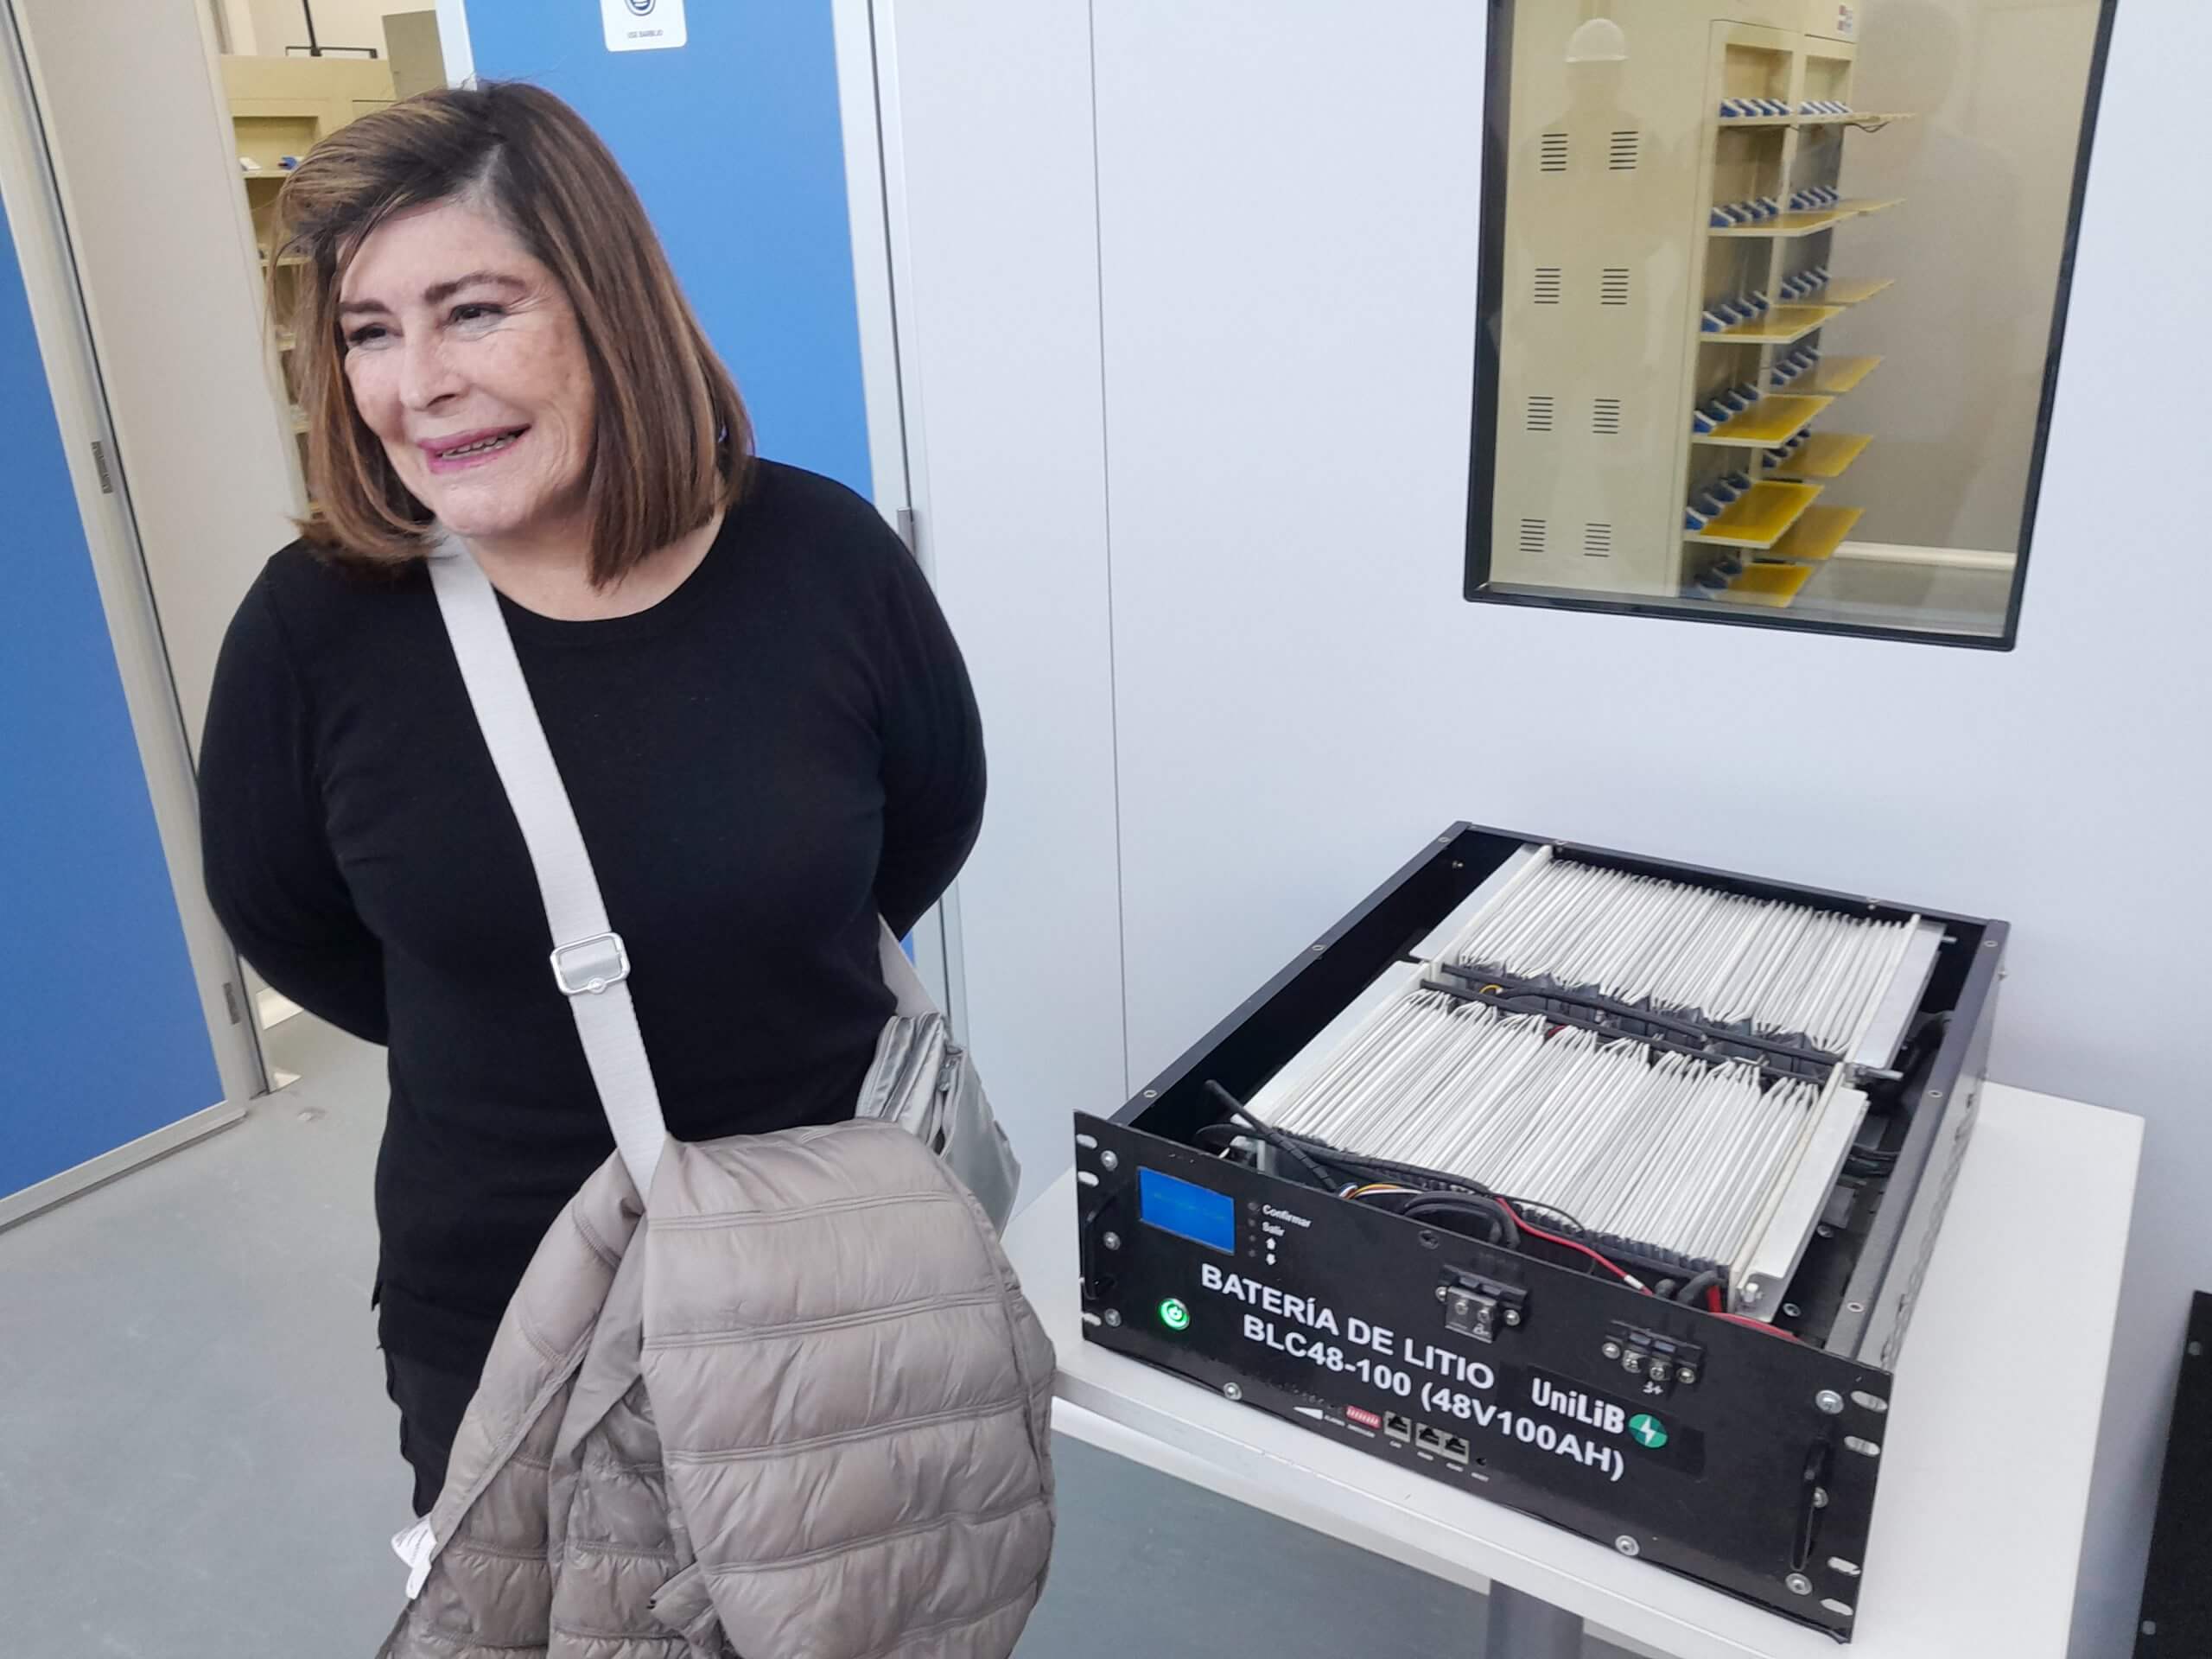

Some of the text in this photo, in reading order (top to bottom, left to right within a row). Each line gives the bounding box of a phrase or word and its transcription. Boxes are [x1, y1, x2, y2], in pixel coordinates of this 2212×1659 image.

[1262, 1204, 1312, 1228] Confirmar
[1201, 1262, 1495, 1389] BATERÍA DE LITIO
[1243, 1313, 1624, 1482] BLC48-100 (48V100AH)
[1531, 1377, 1625, 1434] UniLiB
